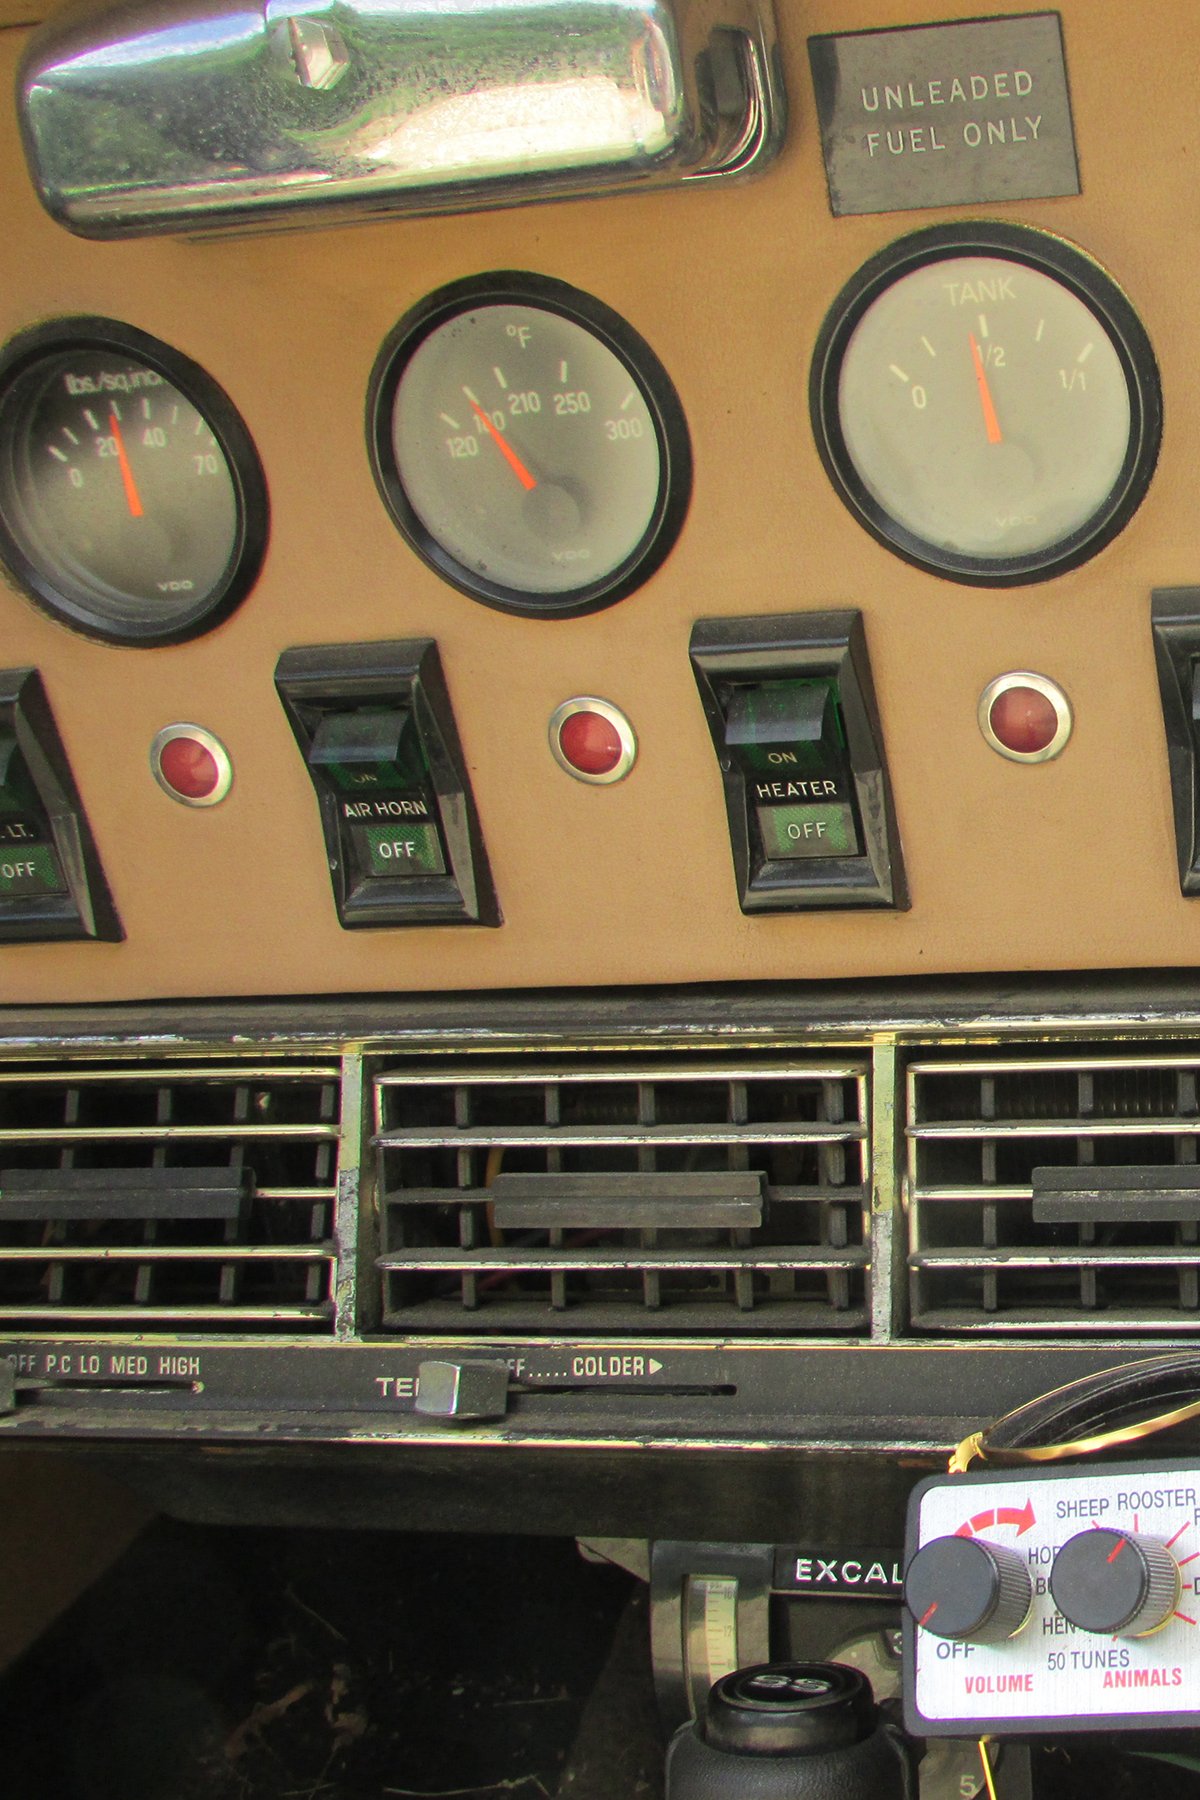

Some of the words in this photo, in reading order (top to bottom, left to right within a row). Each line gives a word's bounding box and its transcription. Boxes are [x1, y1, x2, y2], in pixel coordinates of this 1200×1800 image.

[861, 70, 1033, 112] UNLEADED
[866, 126, 946, 157] FUEL
[963, 115, 1042, 147] ONLY
[944, 276, 1016, 306] TANK
[508, 391, 542, 416] 210
[554, 391, 592, 416] 250
[911, 385, 927, 409] 0
[142, 427, 167, 449] 40
[605, 418, 644, 442] 300
[446, 434, 479, 460] 120
[194, 454, 219, 476] 70
[69, 467, 83, 489] 0
[157, 579, 194, 592] VDO
[768, 752, 798, 765] ON
[756, 780, 838, 799] HEATER
[344, 802, 373, 818] AIR
[374, 800, 429, 816] HORN
[787, 822, 827, 840] OFF
[379, 841, 415, 858] OFF
[2, 861, 36, 879] OFF
[80, 1355, 100, 1374] LO
[111, 1355, 148, 1375] MED
[159, 1356, 200, 1376] HIGH
[573, 1356, 645, 1377] COLDER
[375, 1377, 420, 1397] TE
[1056, 1498, 1110, 1519] SHEEP
[1117, 1488, 1197, 1511] ROOSTER
[936, 1642, 976, 1660] OFF
[1047, 1651, 1066, 1671] 50
[1071, 1648, 1130, 1670] TUNES
[965, 1673, 1034, 1695] VOLUME
[1103, 1667, 1183, 1689] ANIMALS
[960, 1774, 976, 1796] 5
